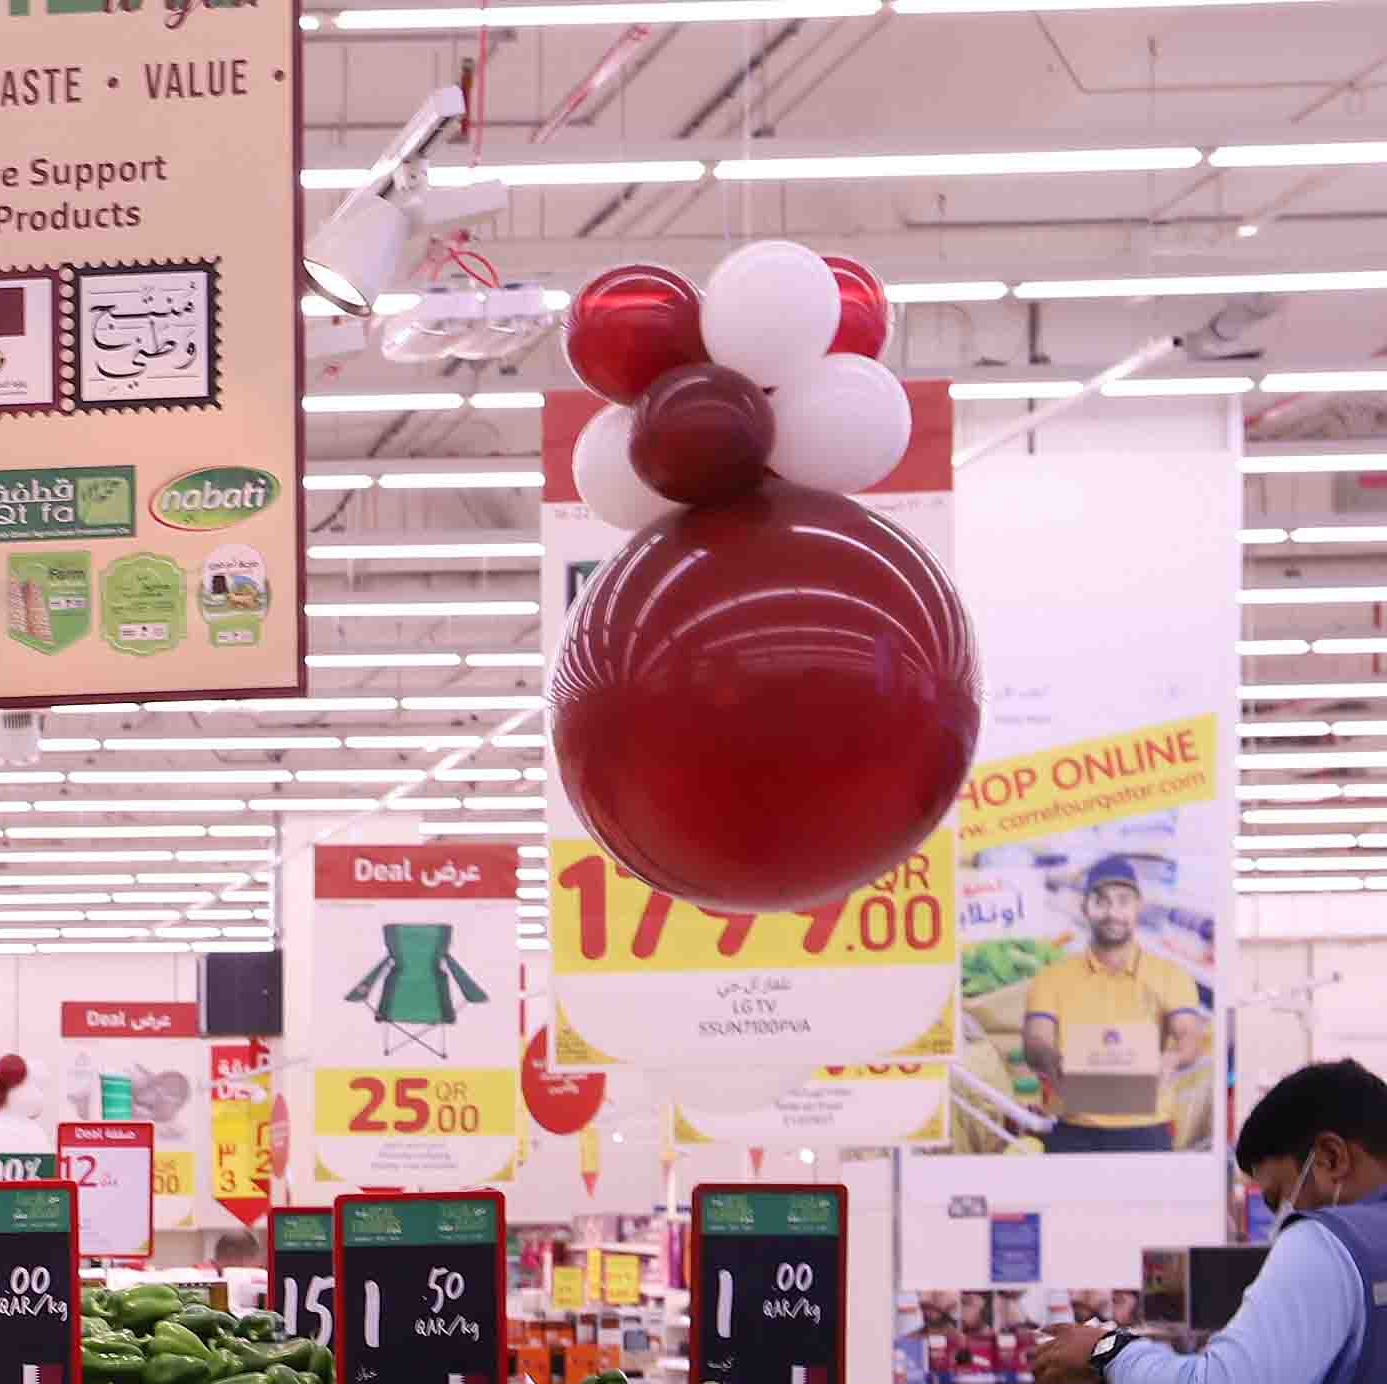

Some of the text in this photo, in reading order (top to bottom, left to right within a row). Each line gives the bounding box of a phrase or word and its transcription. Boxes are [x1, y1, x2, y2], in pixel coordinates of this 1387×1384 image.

[145, 59, 247, 99] VALUE
[30, 156, 167, 191] Support
[160, 475, 267, 513] nabati
[1051, 728, 1200, 795] ONLINE
[355, 859, 480, 887] Deal عرض
[86, 1010, 125, 1027] Deal
[349, 1078, 429, 1132] 25
[435, 1080, 468, 1102] QR
